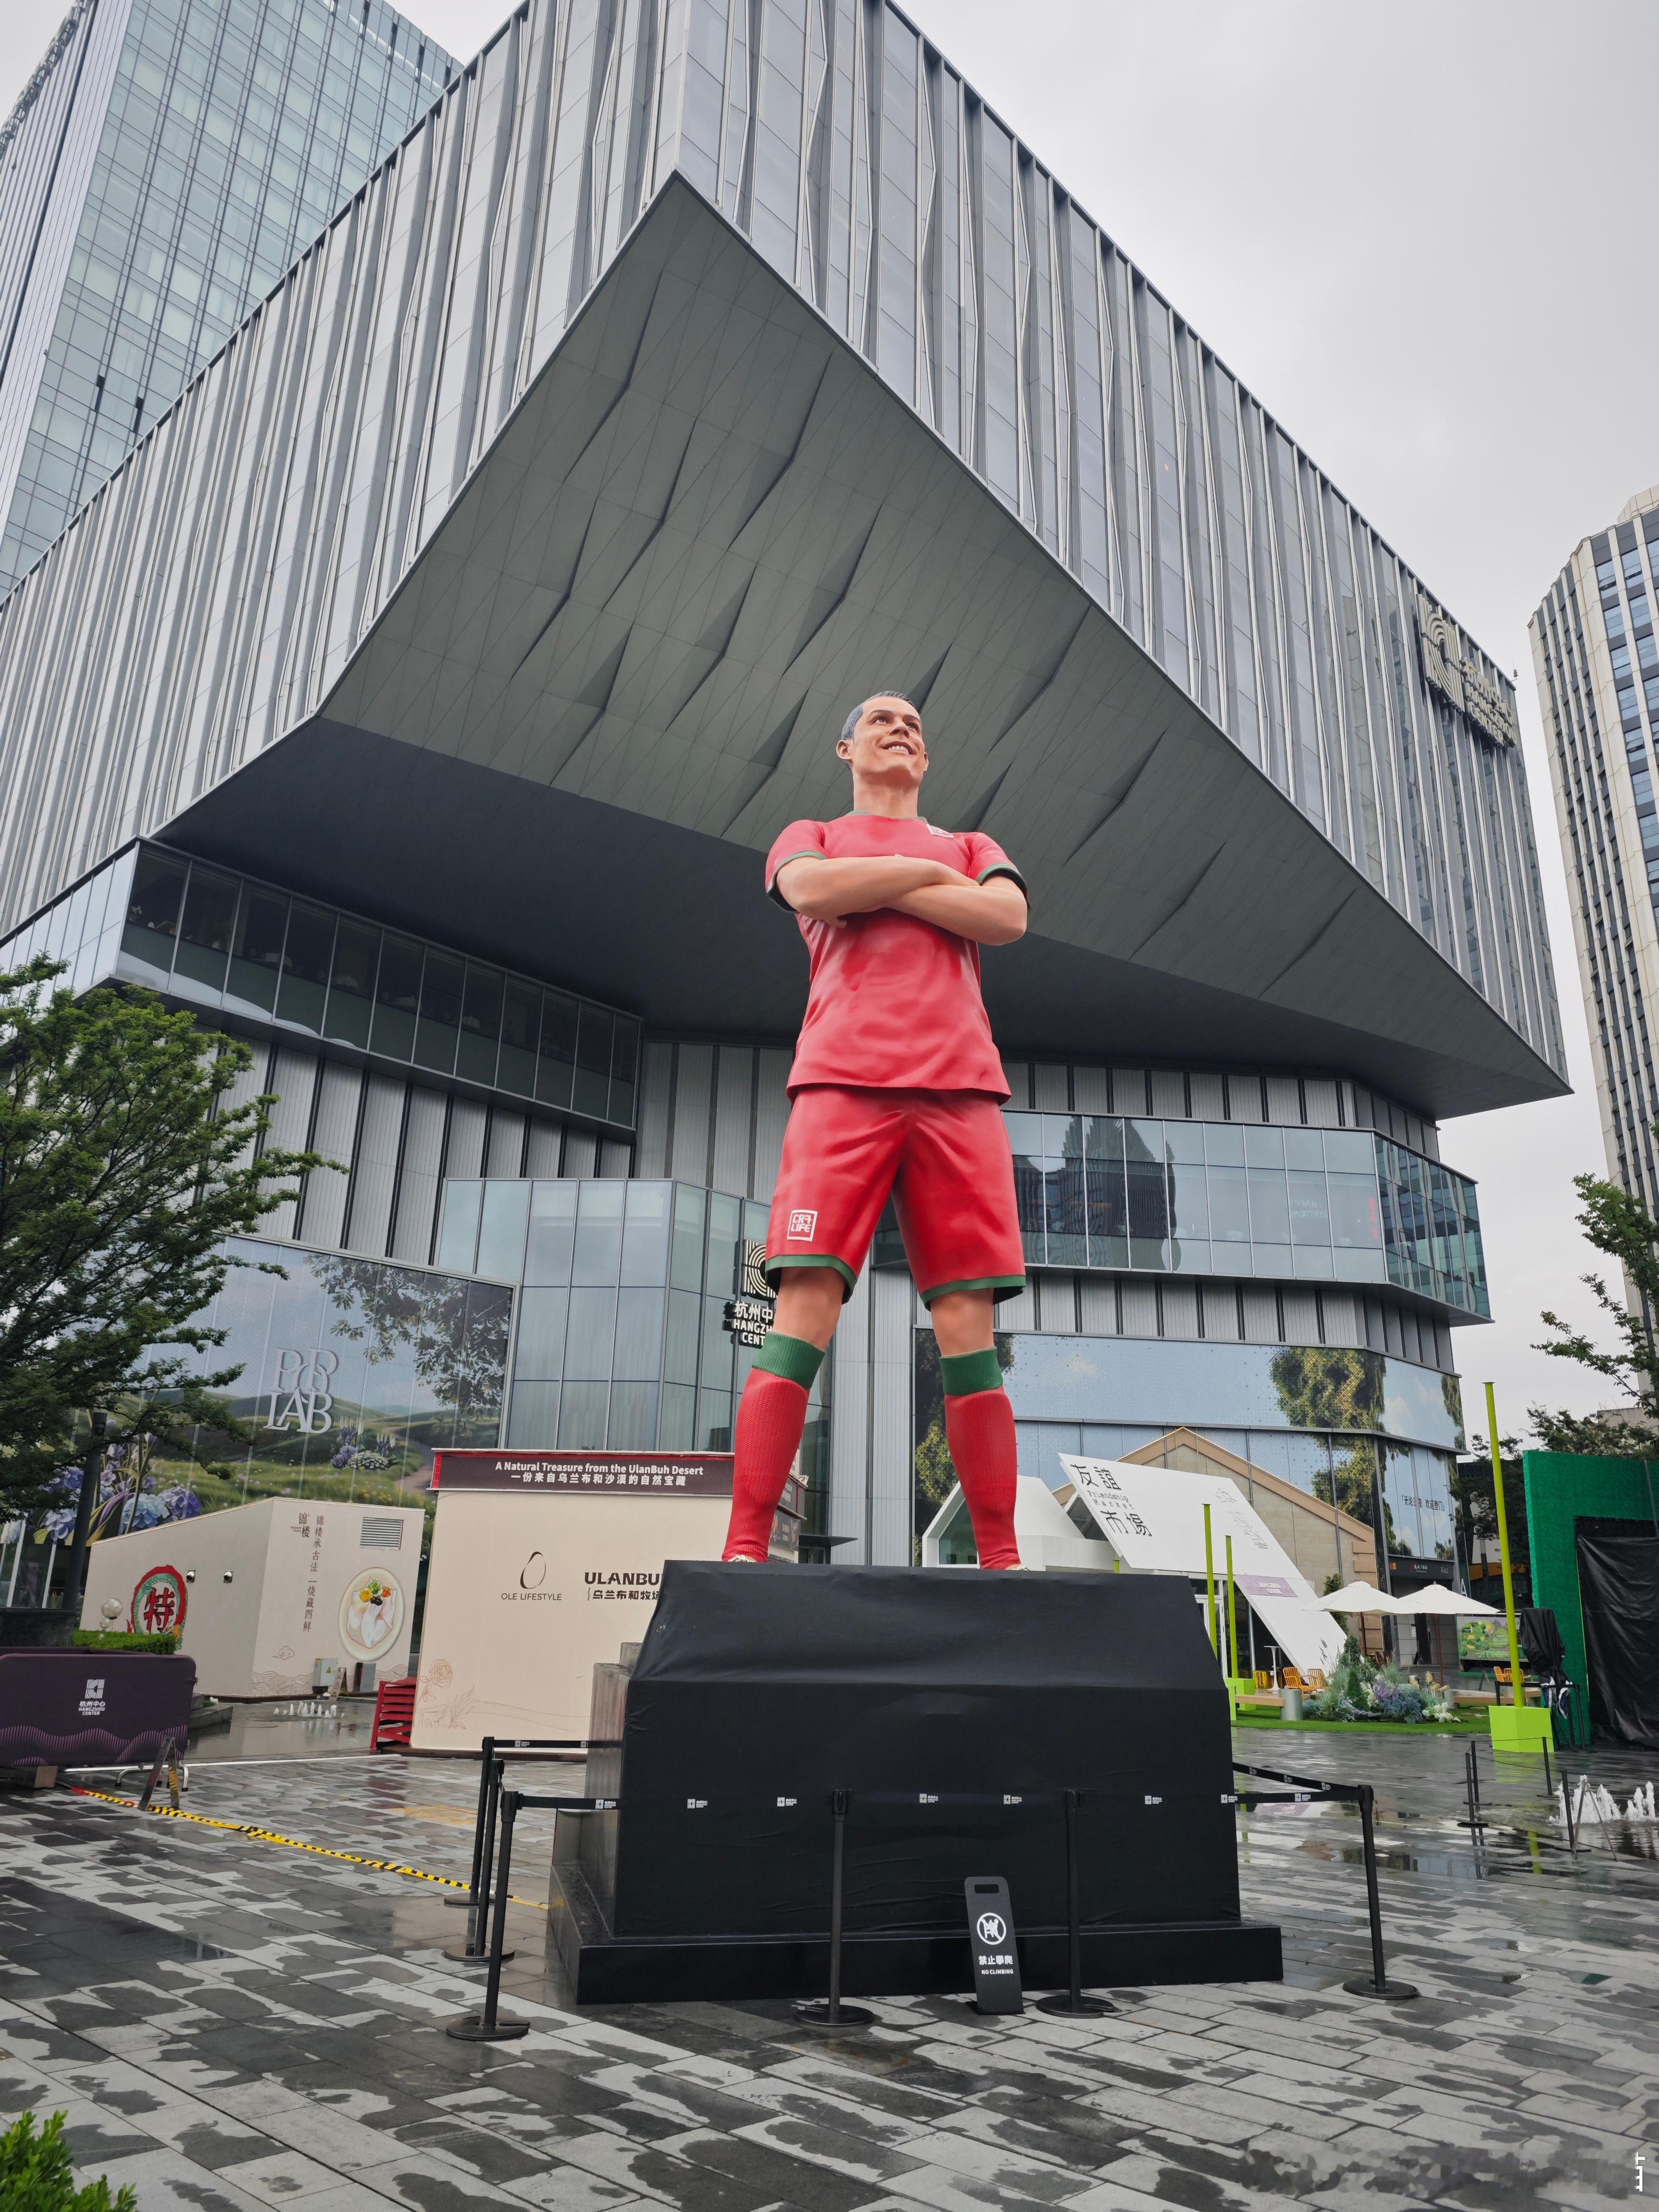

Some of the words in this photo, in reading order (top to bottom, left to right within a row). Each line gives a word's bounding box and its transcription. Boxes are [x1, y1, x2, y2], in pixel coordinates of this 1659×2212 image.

[792, 1214, 812, 1224] CR7
[791, 1223, 811, 1232] LIFE
[263, 1387, 333, 1434] LAB
[495, 1461, 502, 1471] A
[504, 1461, 539, 1472] Natural
[542, 1462, 583, 1472] Treasure
[585, 1463, 608, 1473] from
[610, 1464, 626, 1473] the
[629, 1464, 670, 1475] UlanBuh
[672, 1466, 704, 1475] Desert
[511, 1472, 686, 1486] 一份来自乌兰布和沙漠的自然宝藏
[1087, 1490, 1129, 1503] Friendship
[1100, 1510, 1152, 1537] 市場
[584, 1572, 664, 1586] ULANBU
[520, 1593, 562, 1601] LIFESTYLE
[979, 1955, 1014, 1965] 禁止攀爬
